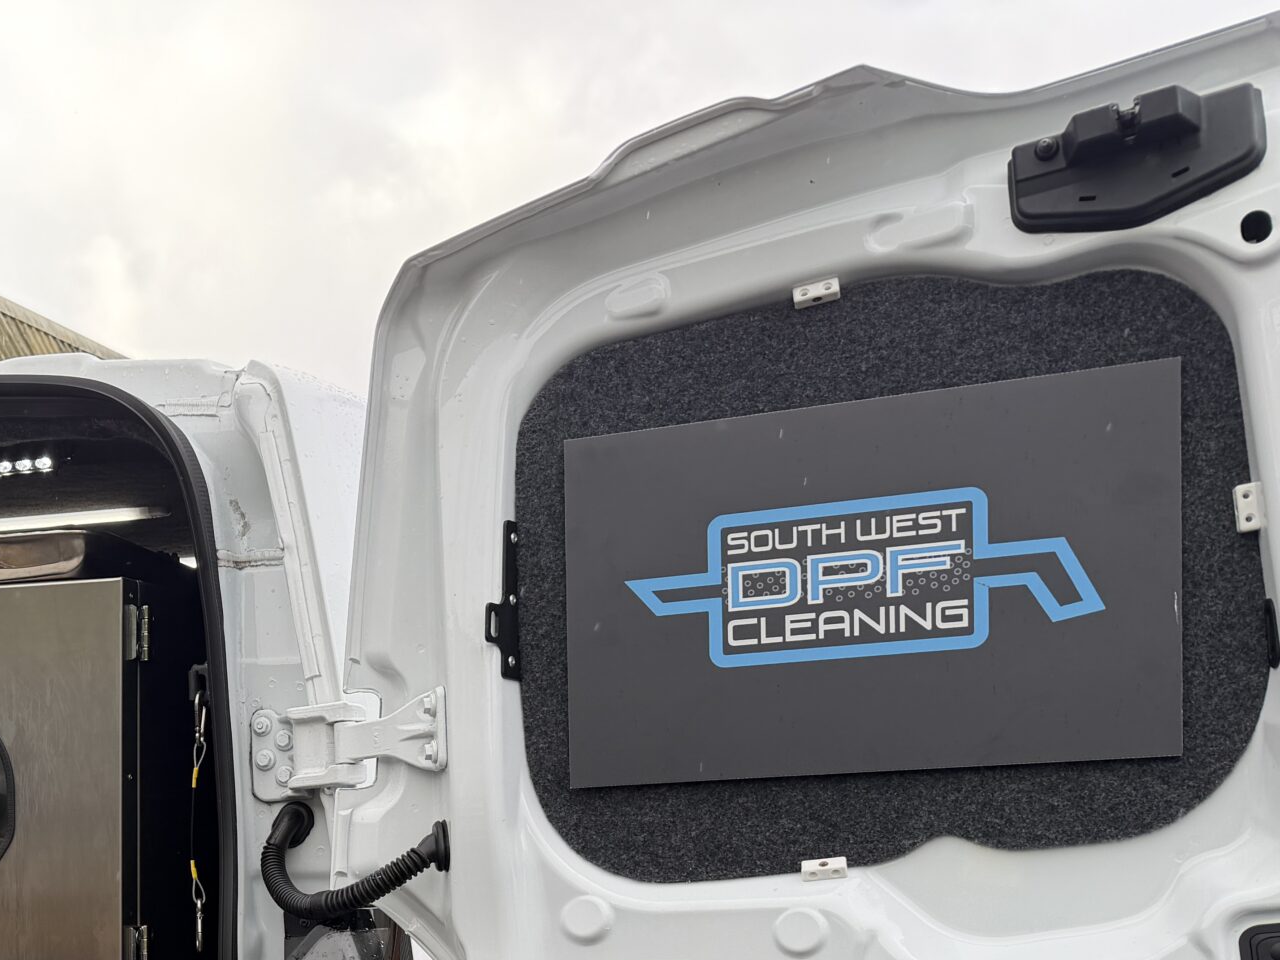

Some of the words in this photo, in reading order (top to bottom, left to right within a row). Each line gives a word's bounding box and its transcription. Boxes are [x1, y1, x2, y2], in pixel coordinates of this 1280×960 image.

[726, 523, 846, 556] SOUTH
[856, 508, 967, 541] WEST
[726, 540, 966, 613] DPF
[726, 599, 970, 647] CLEANING
